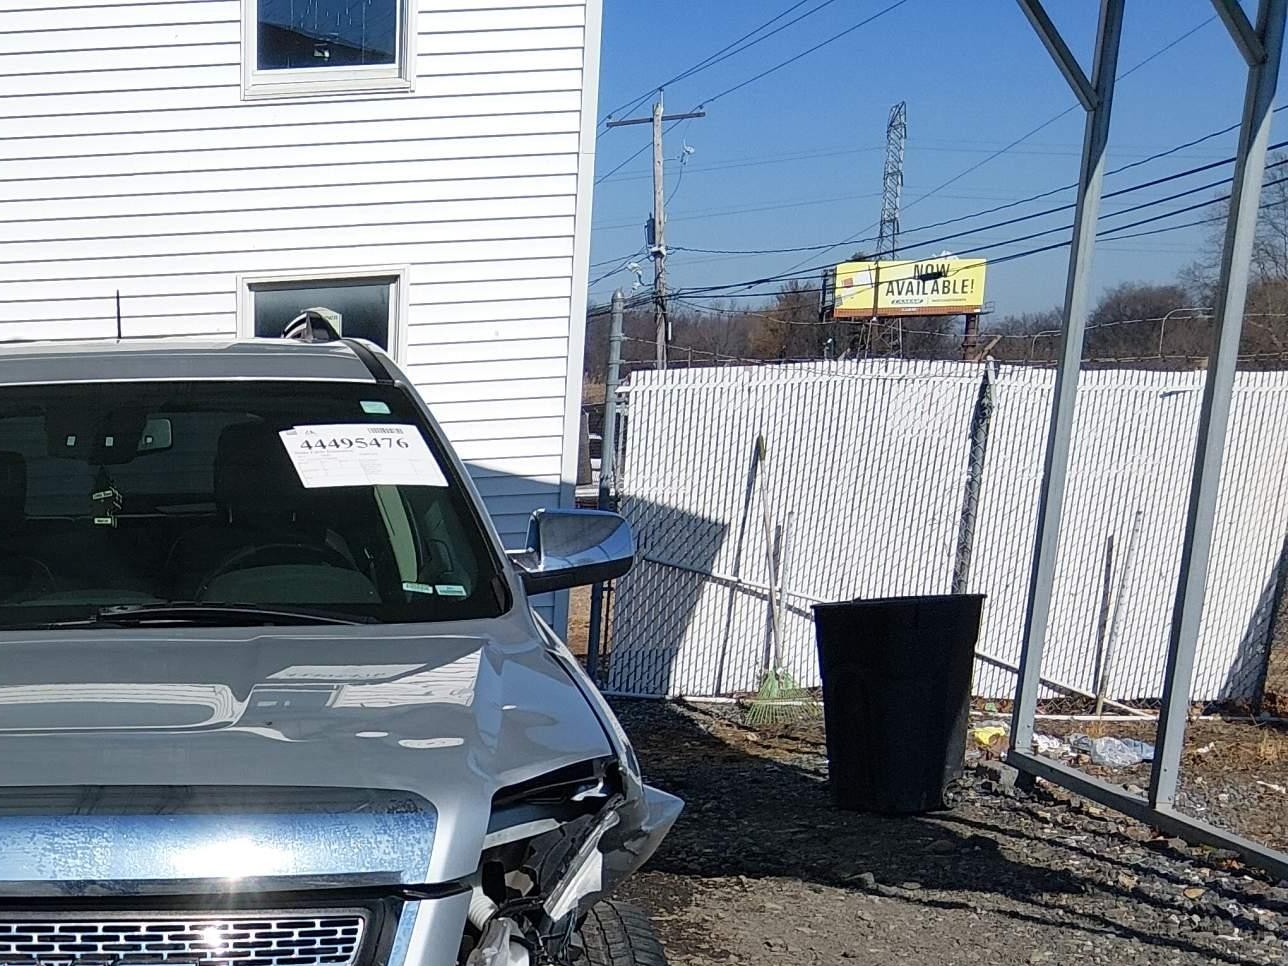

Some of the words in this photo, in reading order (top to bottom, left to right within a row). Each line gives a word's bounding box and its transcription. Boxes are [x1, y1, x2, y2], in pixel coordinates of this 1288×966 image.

[914, 264, 950, 278] NOW
[886, 279, 974, 296] AVAILABLE!
[300, 438, 409, 449] 44495476
